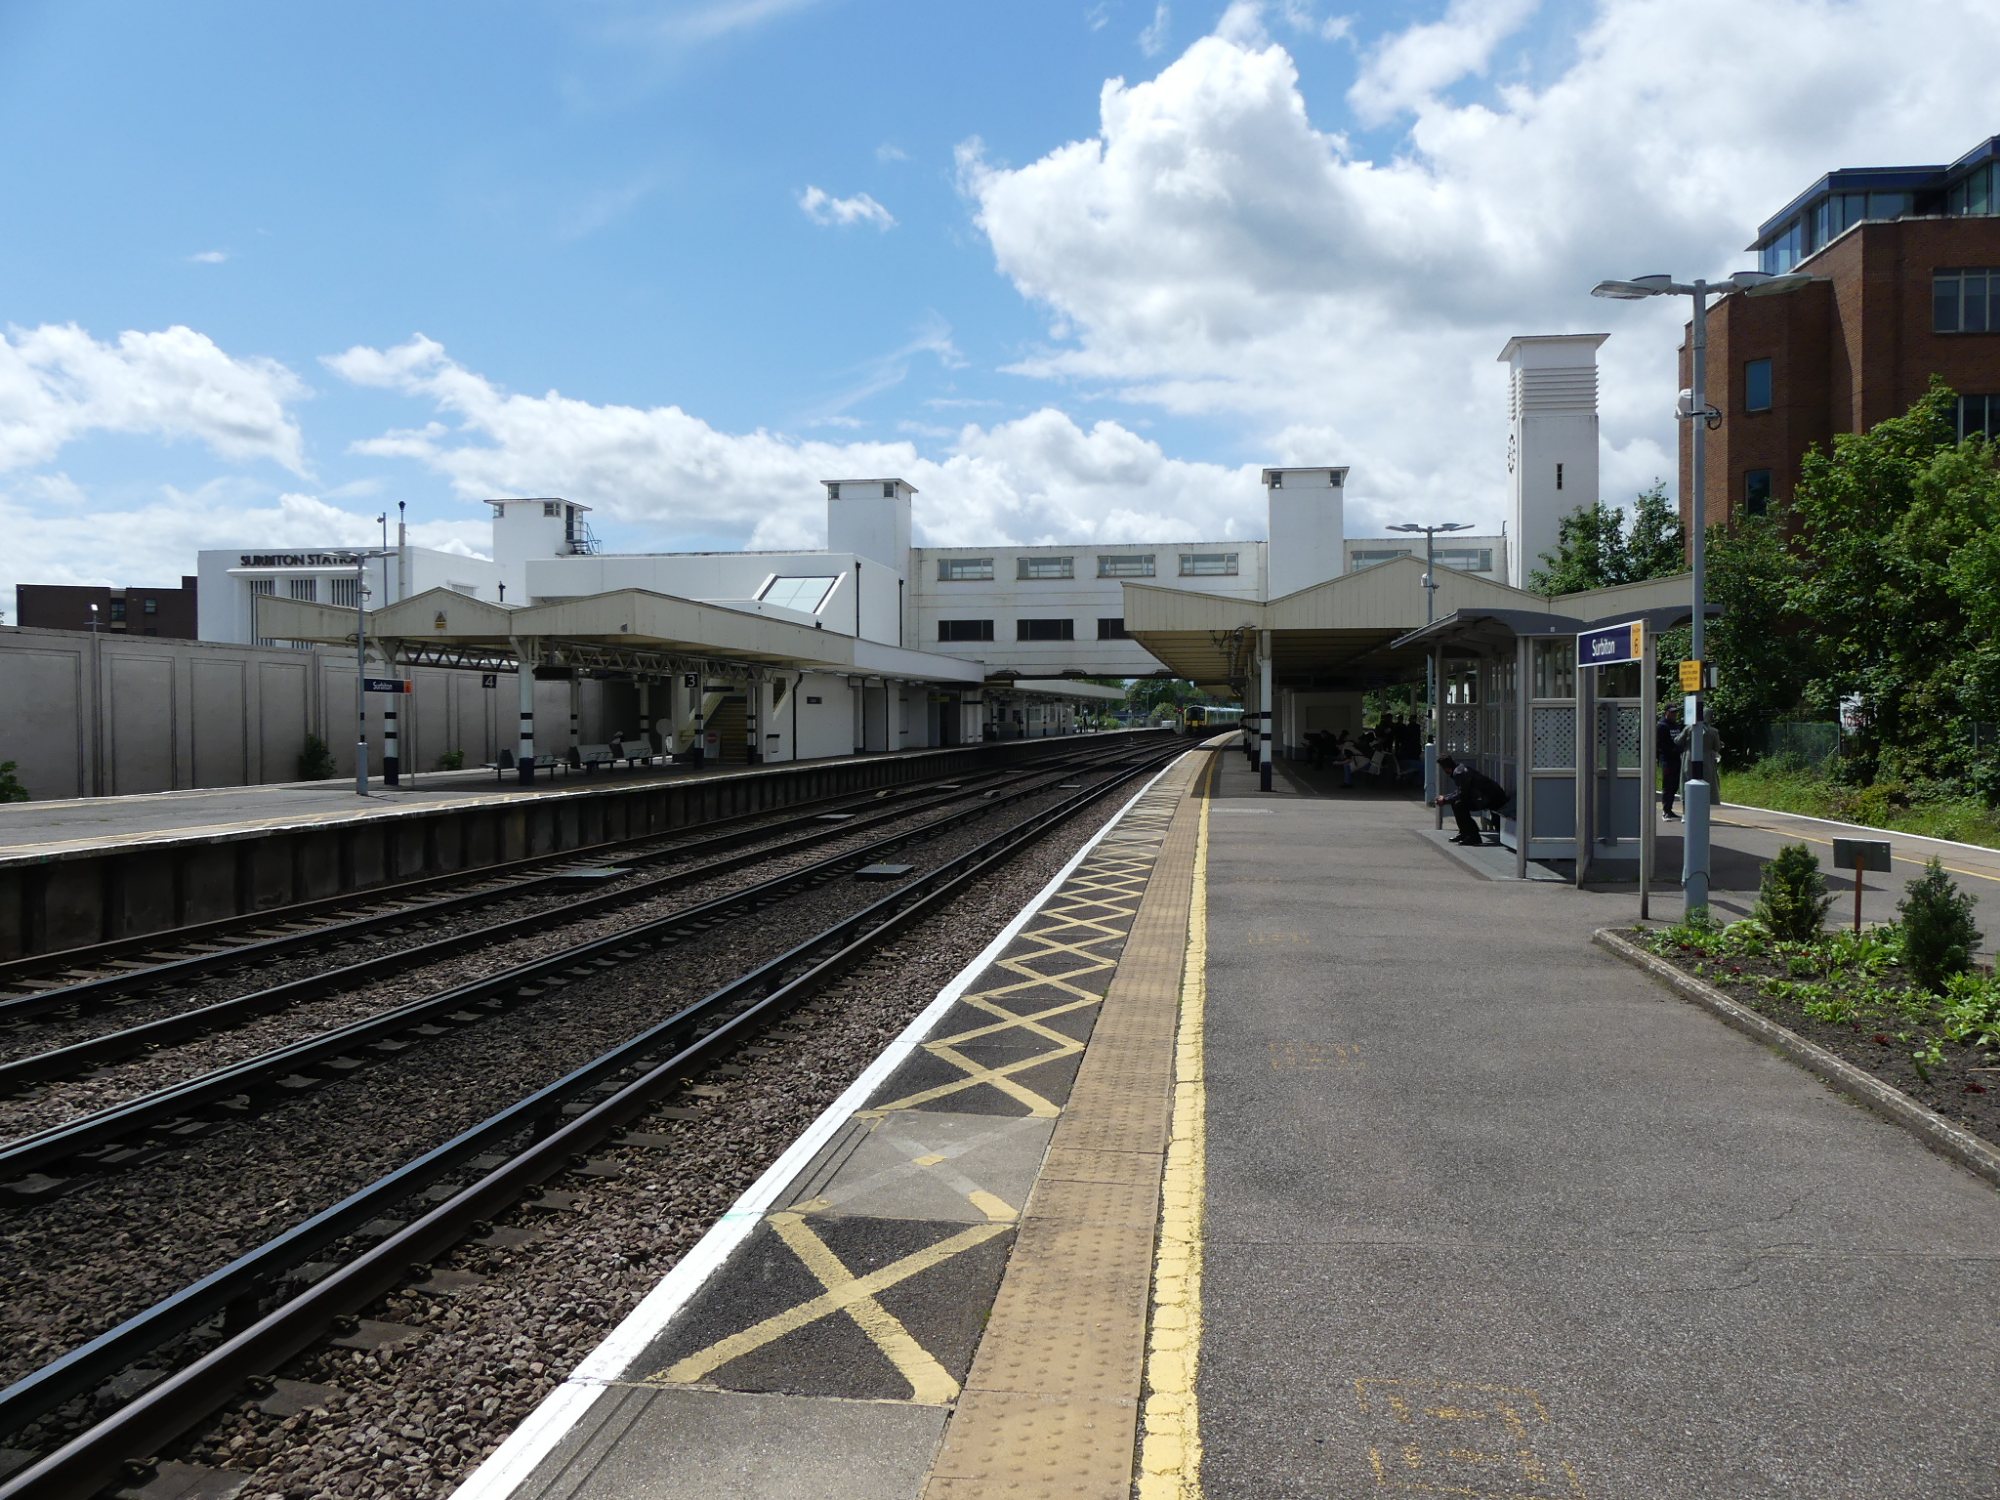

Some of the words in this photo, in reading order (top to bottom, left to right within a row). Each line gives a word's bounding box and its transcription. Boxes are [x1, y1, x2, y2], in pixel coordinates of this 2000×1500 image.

[240, 554, 305, 567] SURBITON
[1592, 638, 1615, 656] Surbiton
[372, 681, 393, 690] Surbiton
[485, 675, 495, 687] 4
[687, 674, 696, 687] 3
